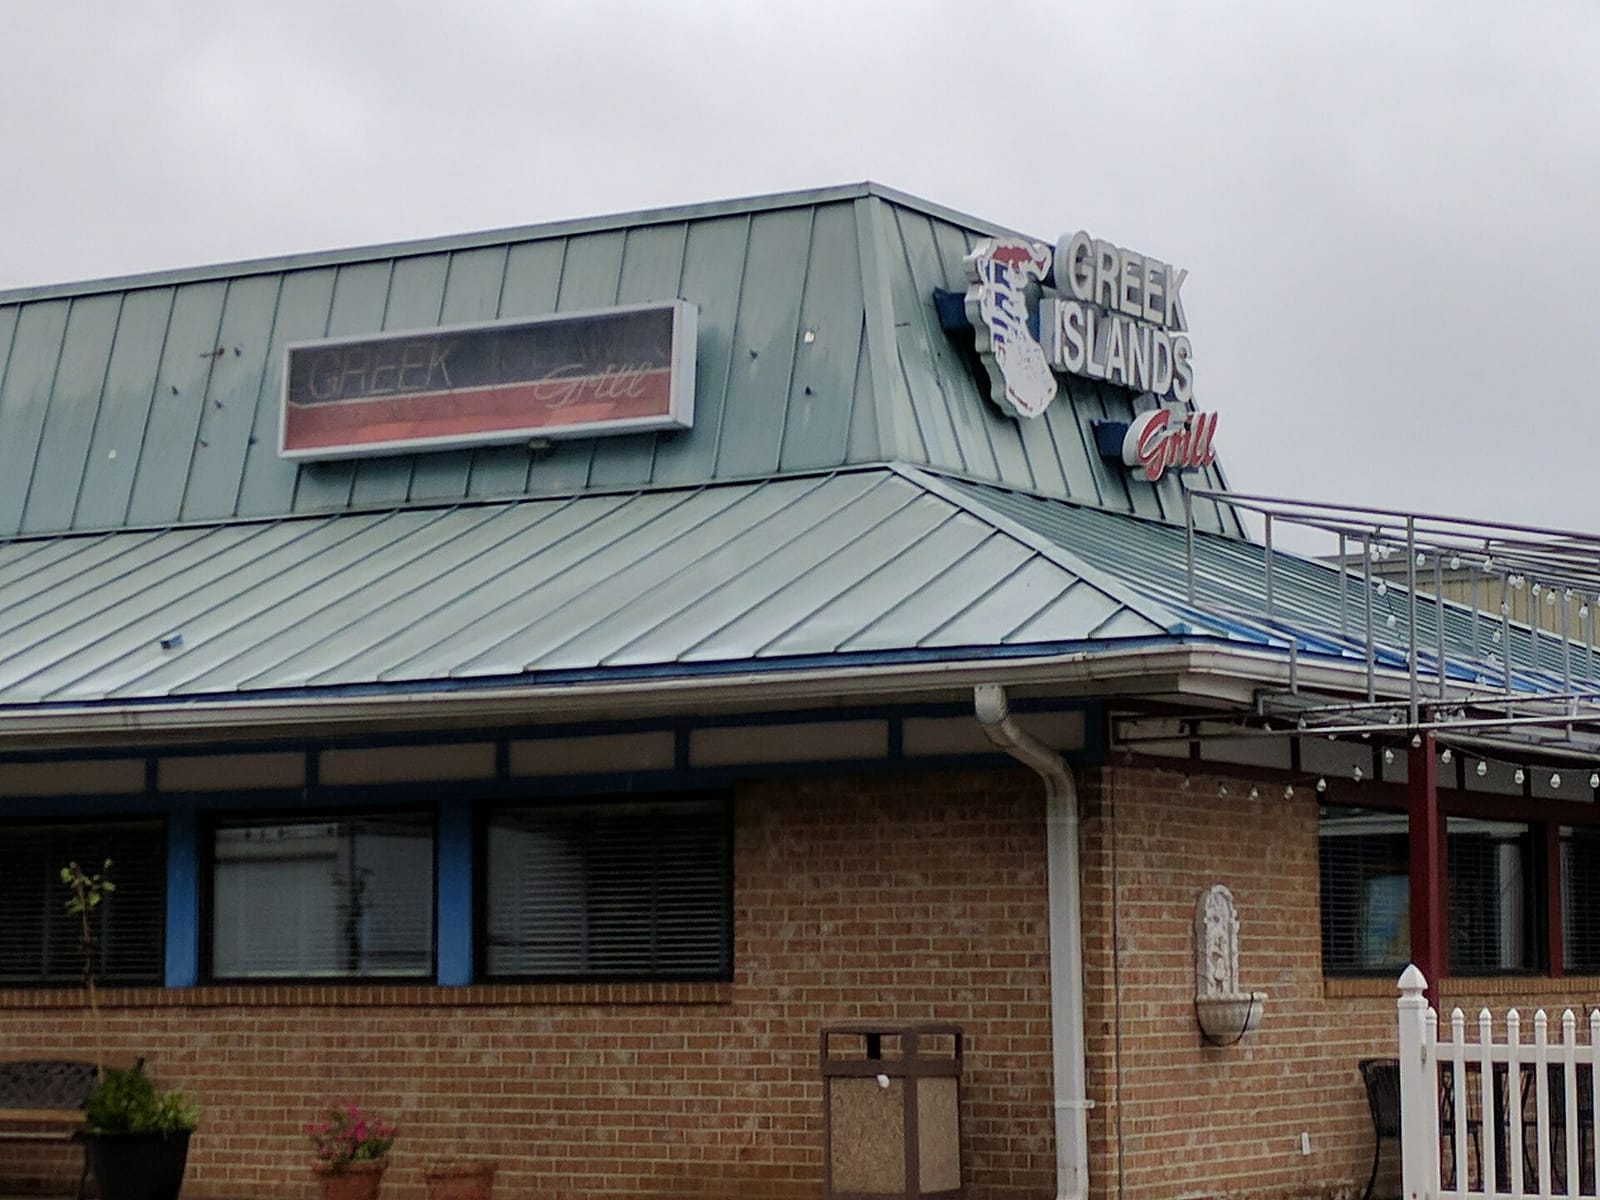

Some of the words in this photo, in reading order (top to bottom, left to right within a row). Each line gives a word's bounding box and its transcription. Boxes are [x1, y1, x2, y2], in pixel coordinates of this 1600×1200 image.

[1060, 230, 1188, 332] GREEK
[533, 361, 655, 410] Grill
[1051, 298, 1193, 403] ISLANDS
[1134, 409, 1218, 480] Grill
